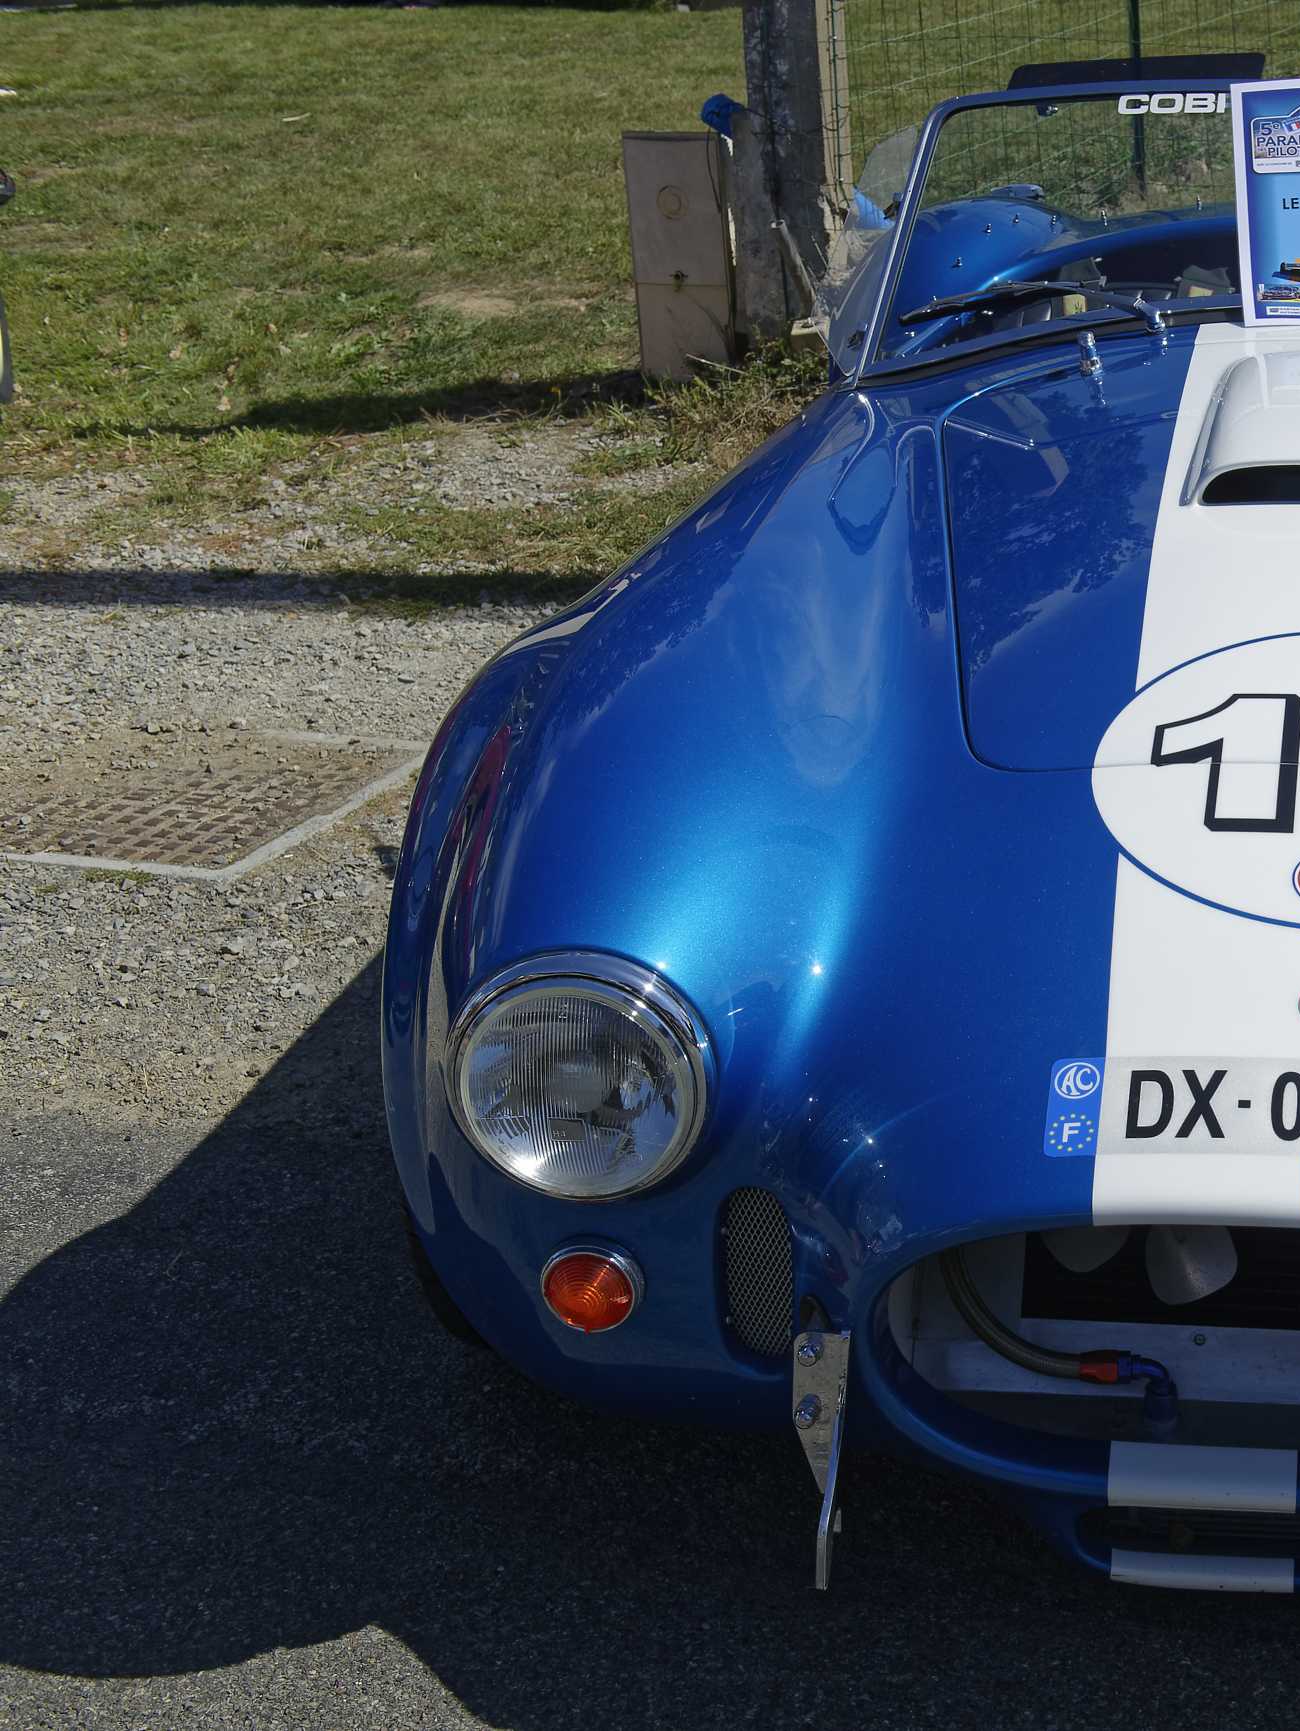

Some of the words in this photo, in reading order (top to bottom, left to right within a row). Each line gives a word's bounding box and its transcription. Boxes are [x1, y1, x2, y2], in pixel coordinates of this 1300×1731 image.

[1118, 93, 1226, 114] COB
[1260, 122, 1279, 136] 5e
[1282, 198, 1299, 209] LE
[1061, 1066, 1094, 1095] AC
[1062, 1122, 1081, 1143] F
